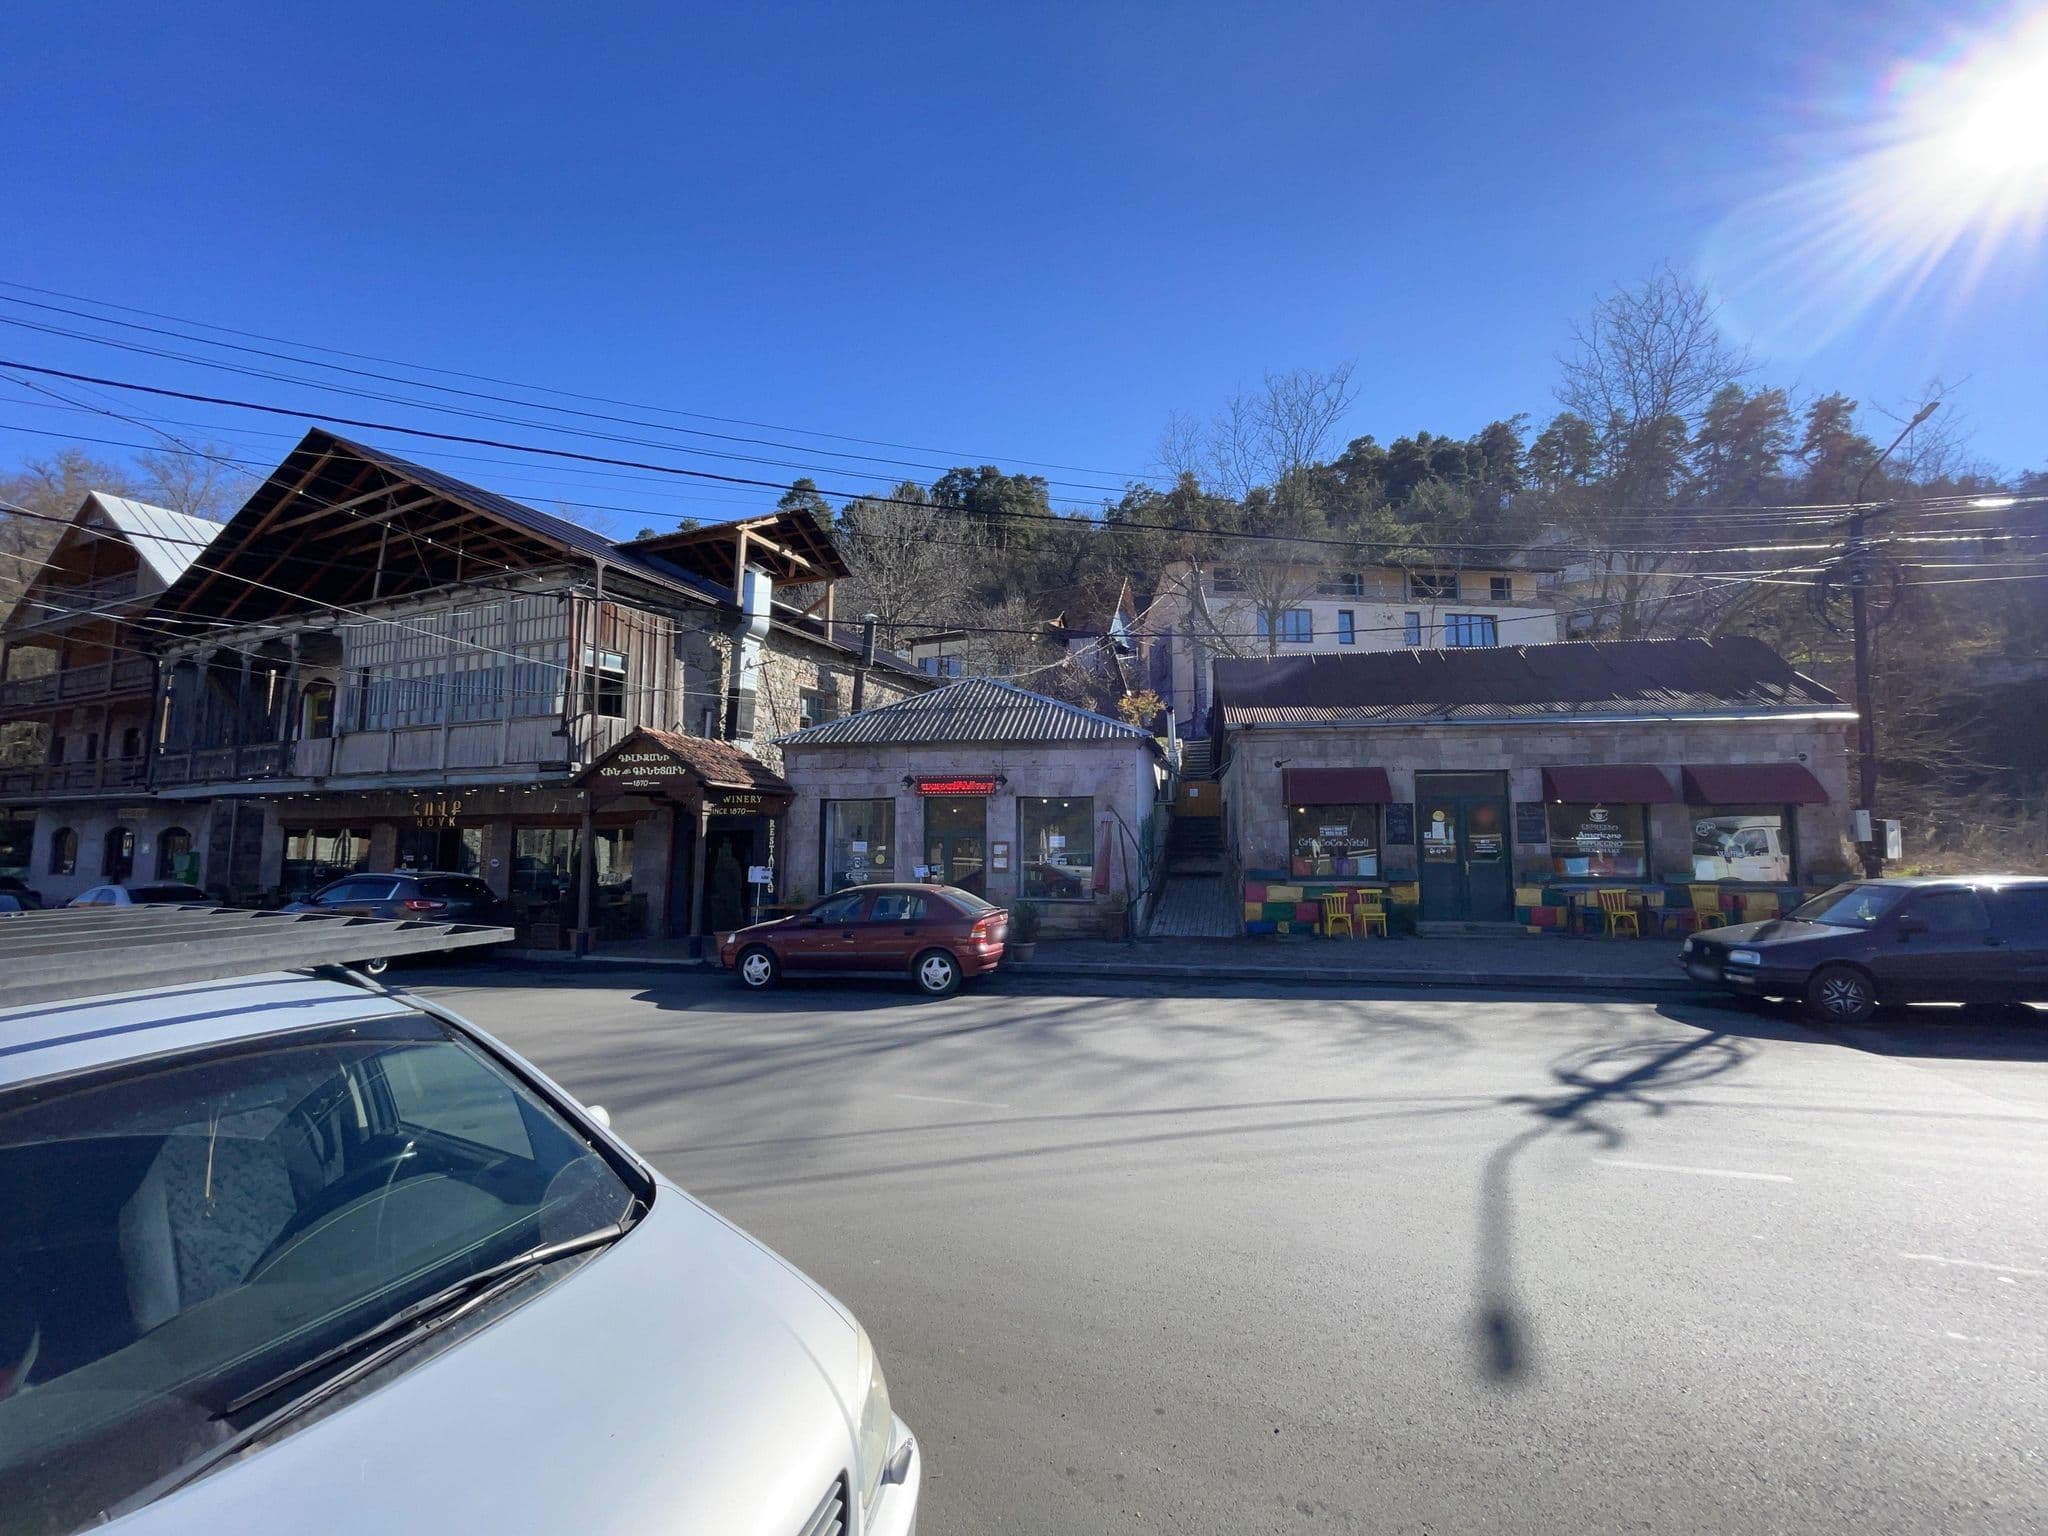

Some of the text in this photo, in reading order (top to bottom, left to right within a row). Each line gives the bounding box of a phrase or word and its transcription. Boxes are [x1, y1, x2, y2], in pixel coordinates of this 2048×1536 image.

[723, 794, 763, 804] WINERY
[730, 807, 747, 816] 1870
[417, 817, 455, 827] HOVK
